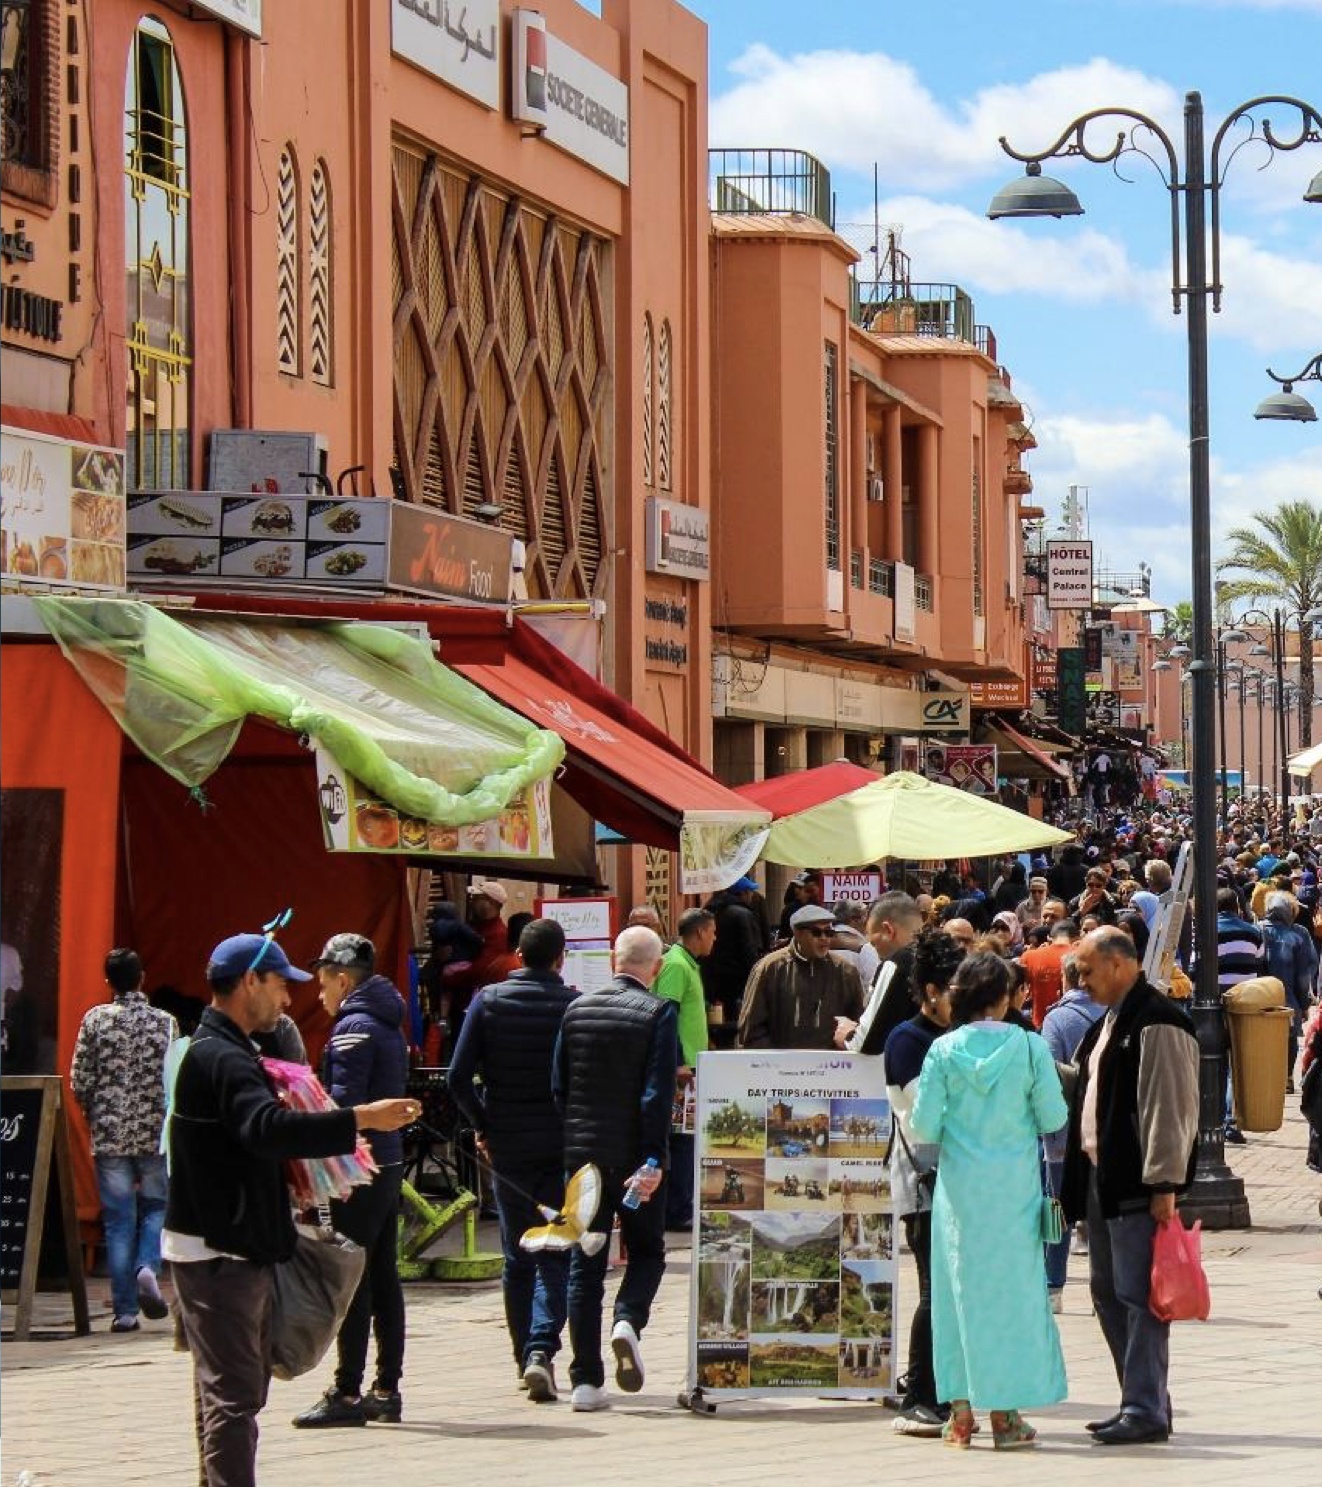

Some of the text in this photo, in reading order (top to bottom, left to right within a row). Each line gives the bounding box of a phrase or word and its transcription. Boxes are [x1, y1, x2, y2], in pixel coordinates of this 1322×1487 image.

[547, 73, 627, 148] SOCIETE GENERALE
[1050, 546, 1090, 560] HÔTEL
[1052, 568, 1089, 576] Central
[469, 559, 494, 599] Food
[1053, 582, 1087, 591] Palace
[987, 682, 1019, 692] Exchange
[987, 693, 1019, 702] Wechsel
[832, 875, 869, 887] NAIM
[832, 889, 872, 901] FOOD
[747, 1088, 768, 1098] DAY
